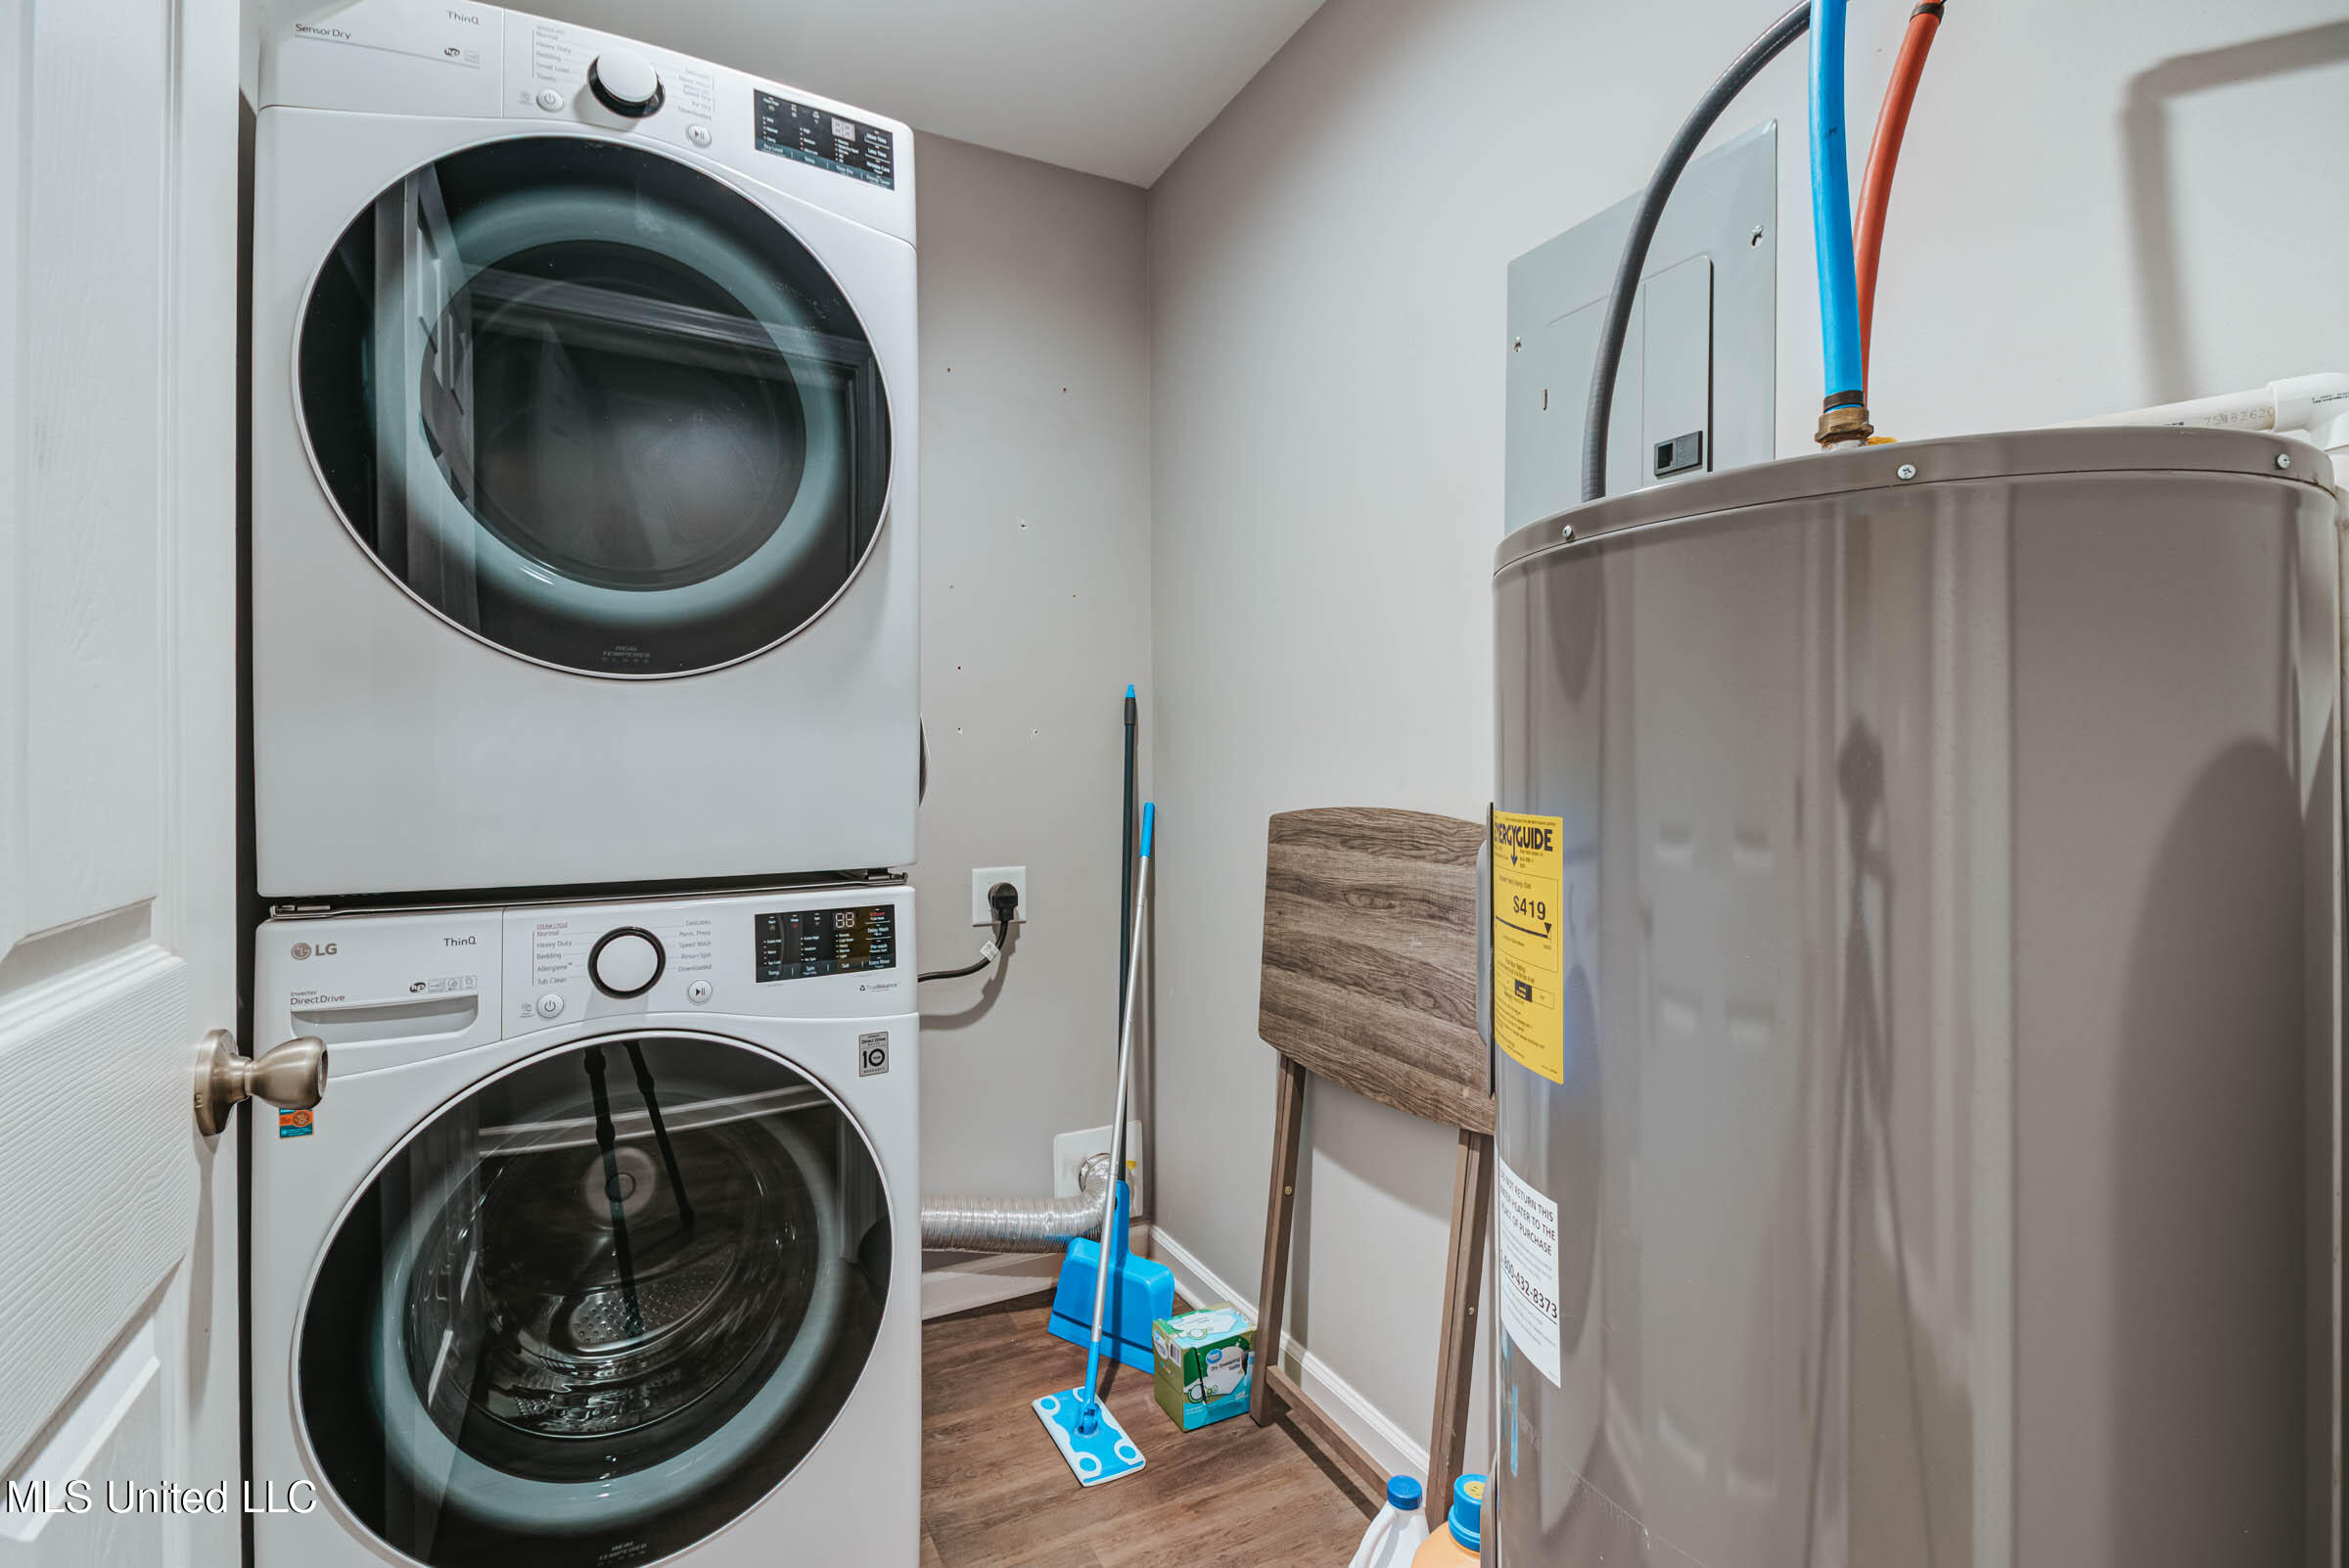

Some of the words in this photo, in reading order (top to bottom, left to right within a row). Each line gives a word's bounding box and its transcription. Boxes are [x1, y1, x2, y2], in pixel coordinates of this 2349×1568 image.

[446, 10, 480, 25] ThinQ
[1512, 895, 1546, 921] $419
[315, 943, 338, 956] LG
[443, 936, 477, 947] ThinQ
[557, 940, 573, 948] Duty
[862, 1047, 886, 1069] 10
[1538, 1204, 1554, 1222] THIS
[1531, 1216, 1541, 1230] TO
[1542, 1222, 1556, 1241] THE
[1519, 1222, 1552, 1257] PURCHASE
